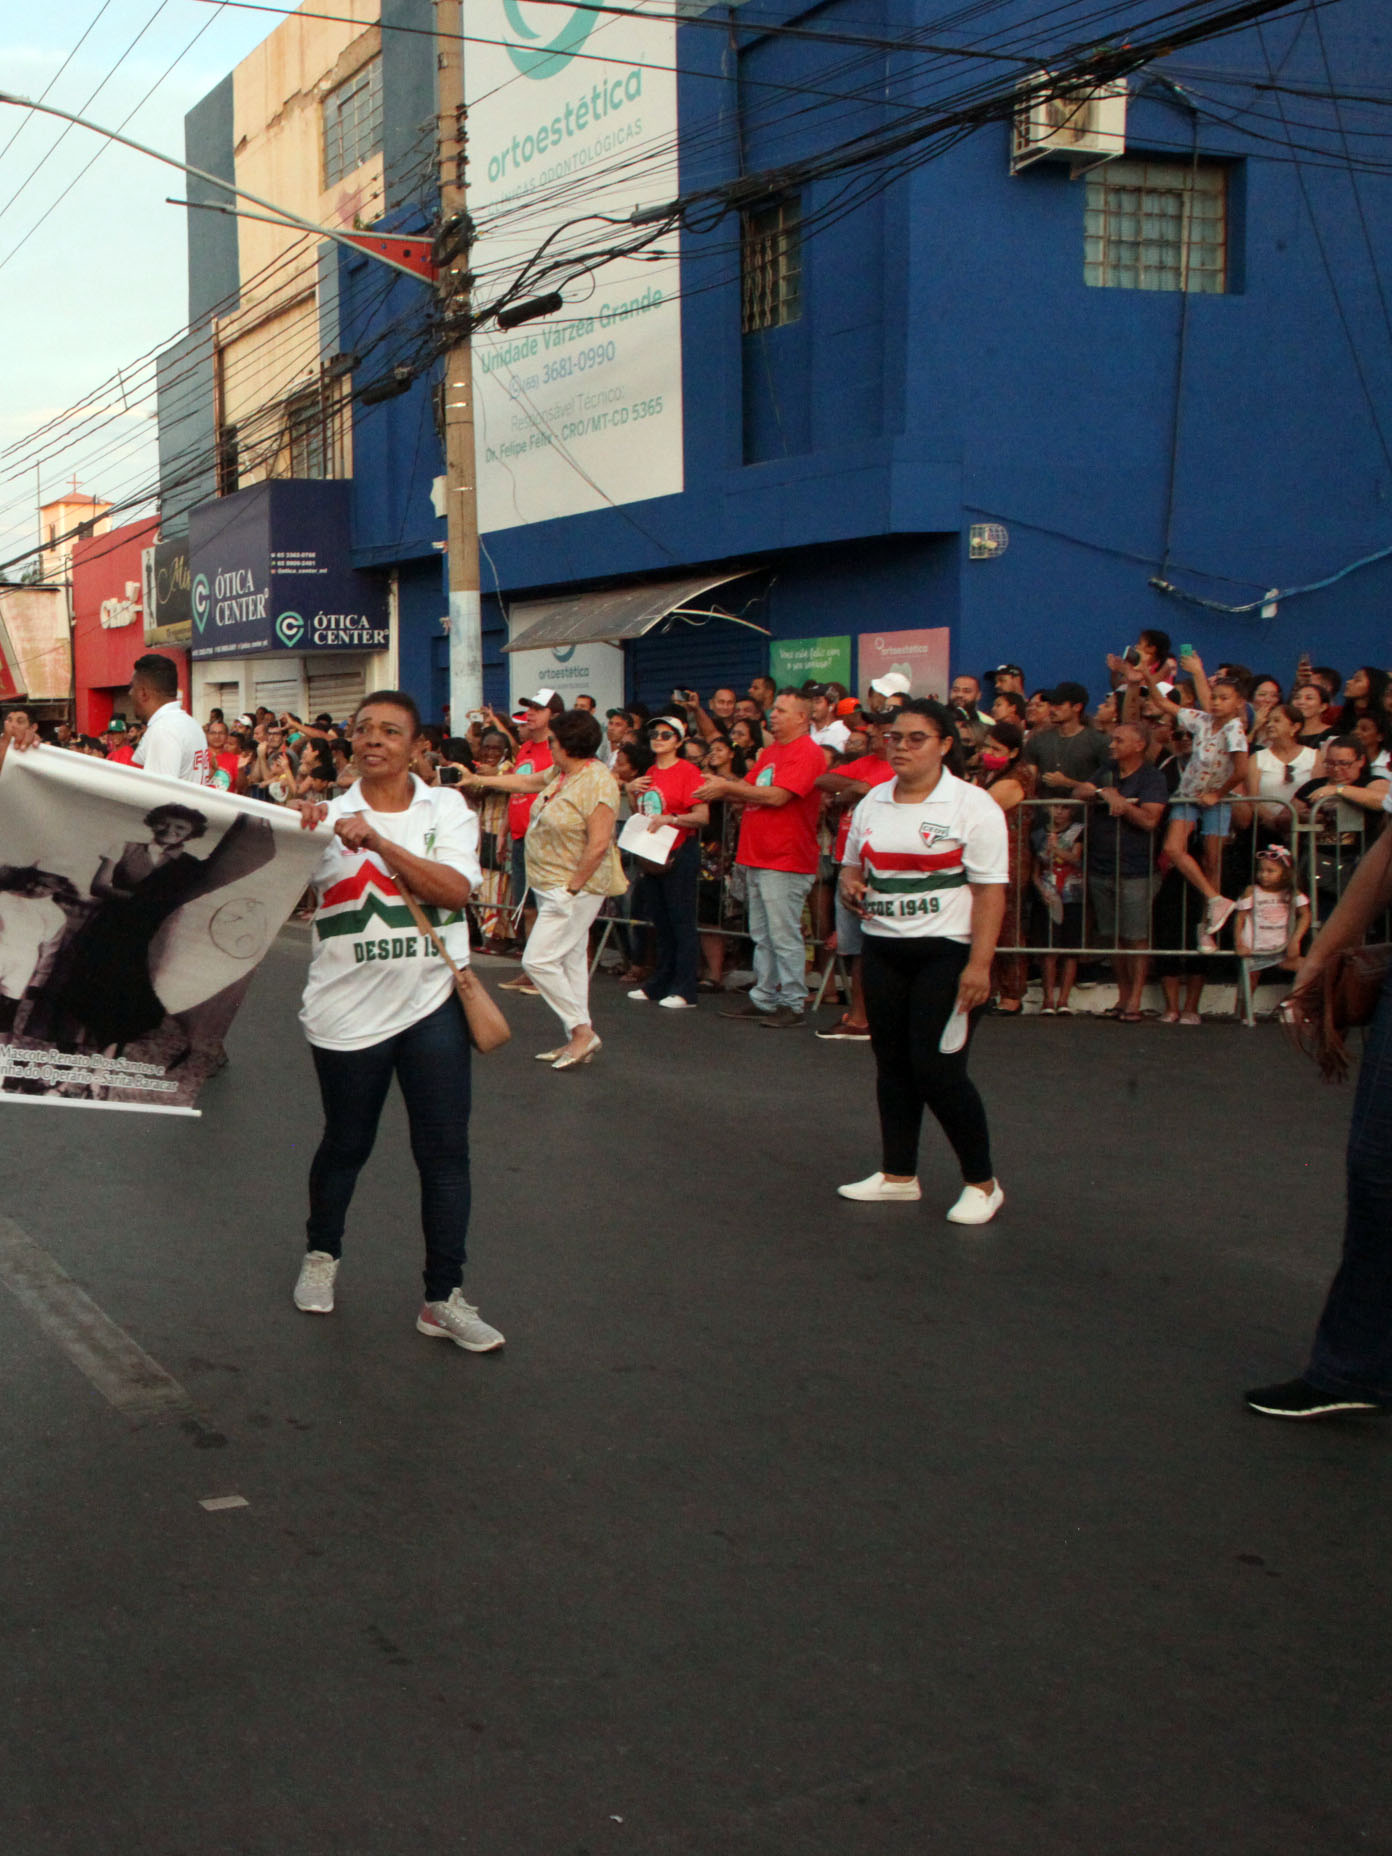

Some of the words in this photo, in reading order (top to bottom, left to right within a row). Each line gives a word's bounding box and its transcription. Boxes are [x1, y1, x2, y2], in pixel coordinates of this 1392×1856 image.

[487, 67, 642, 183] ortoestética
[481, 335, 538, 374] Unidade
[599, 286, 664, 329] Grande
[542, 340, 616, 385] 3681-0990
[631, 395, 664, 421] 5365
[215, 568, 255, 599] ÓTICA
[215, 594, 267, 627] CENTER
[314, 611, 371, 629] ÓTICA
[314, 629, 386, 645] CENTER
[899, 897, 940, 917] 1949
[353, 936, 418, 964] DESDE
[48, 1049, 90, 1068] Renato
